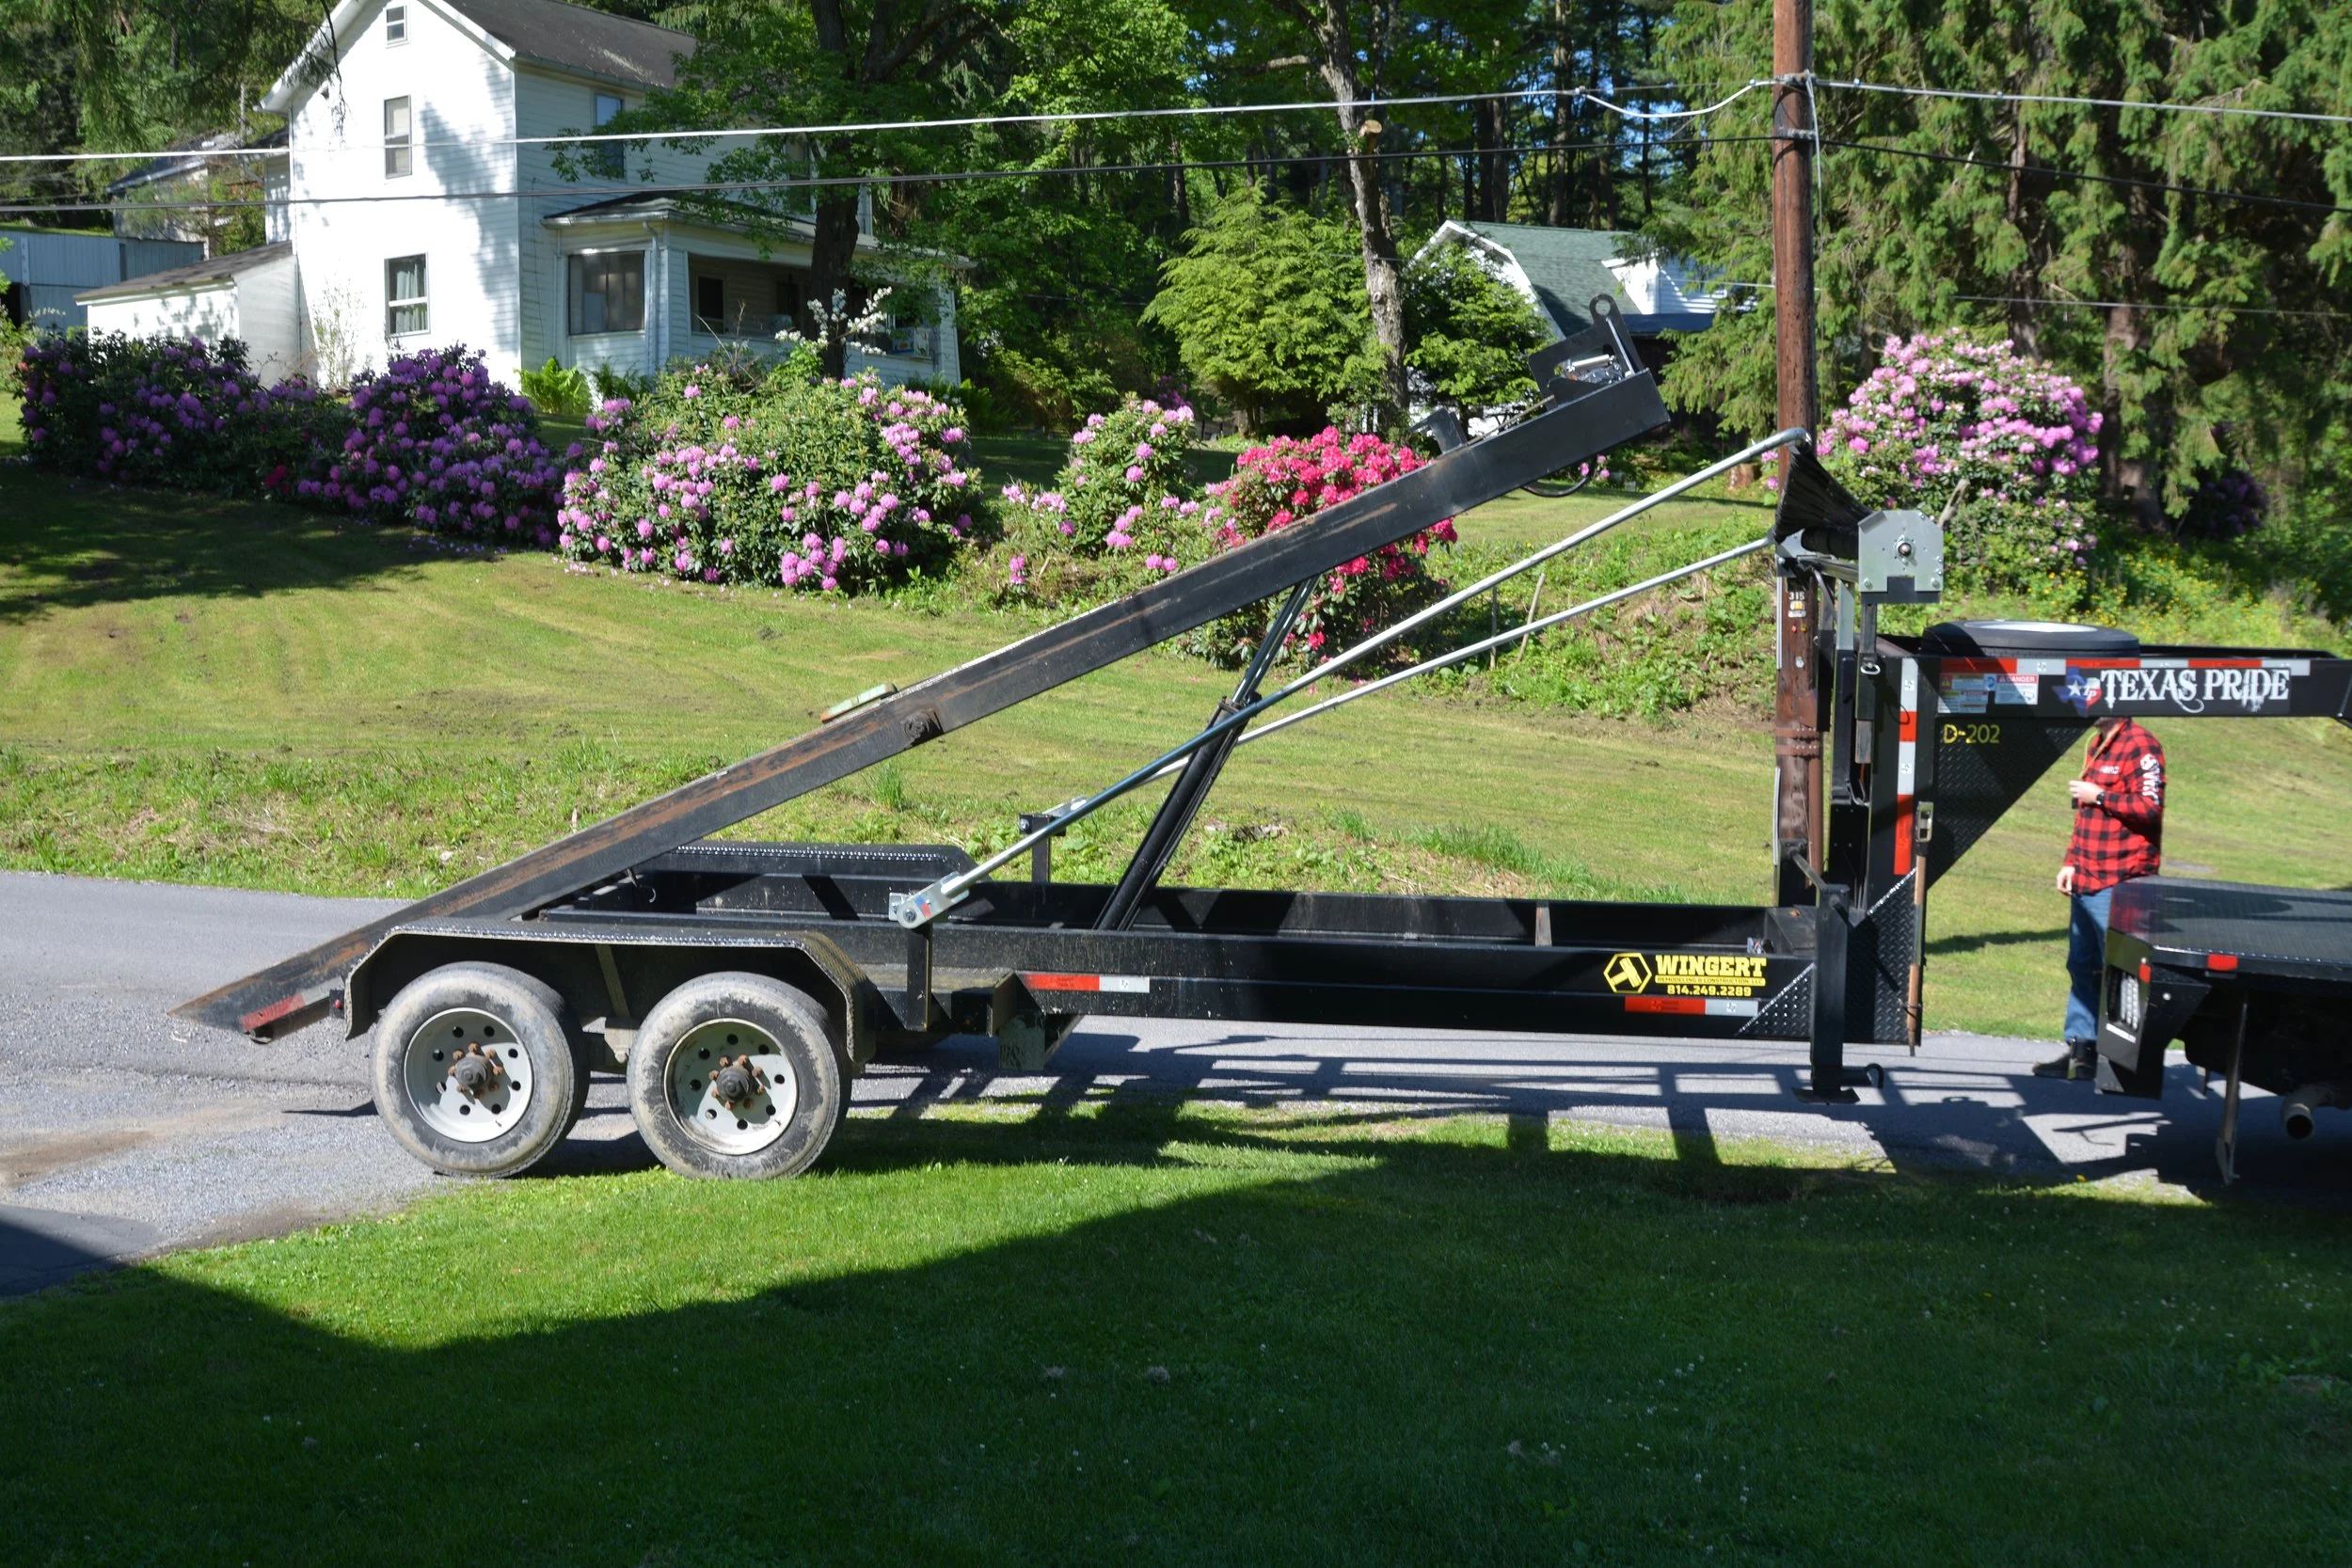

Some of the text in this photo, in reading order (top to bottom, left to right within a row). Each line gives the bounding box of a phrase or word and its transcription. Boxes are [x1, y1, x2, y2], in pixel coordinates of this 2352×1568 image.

[1788, 592, 1805, 600] 315
[2100, 669, 2290, 713] TEXAS PRIDE
[1943, 723, 2001, 743] D-202
[1656, 955, 1767, 976] WINGERT
[1667, 985, 1752, 997] 814.249.2289
